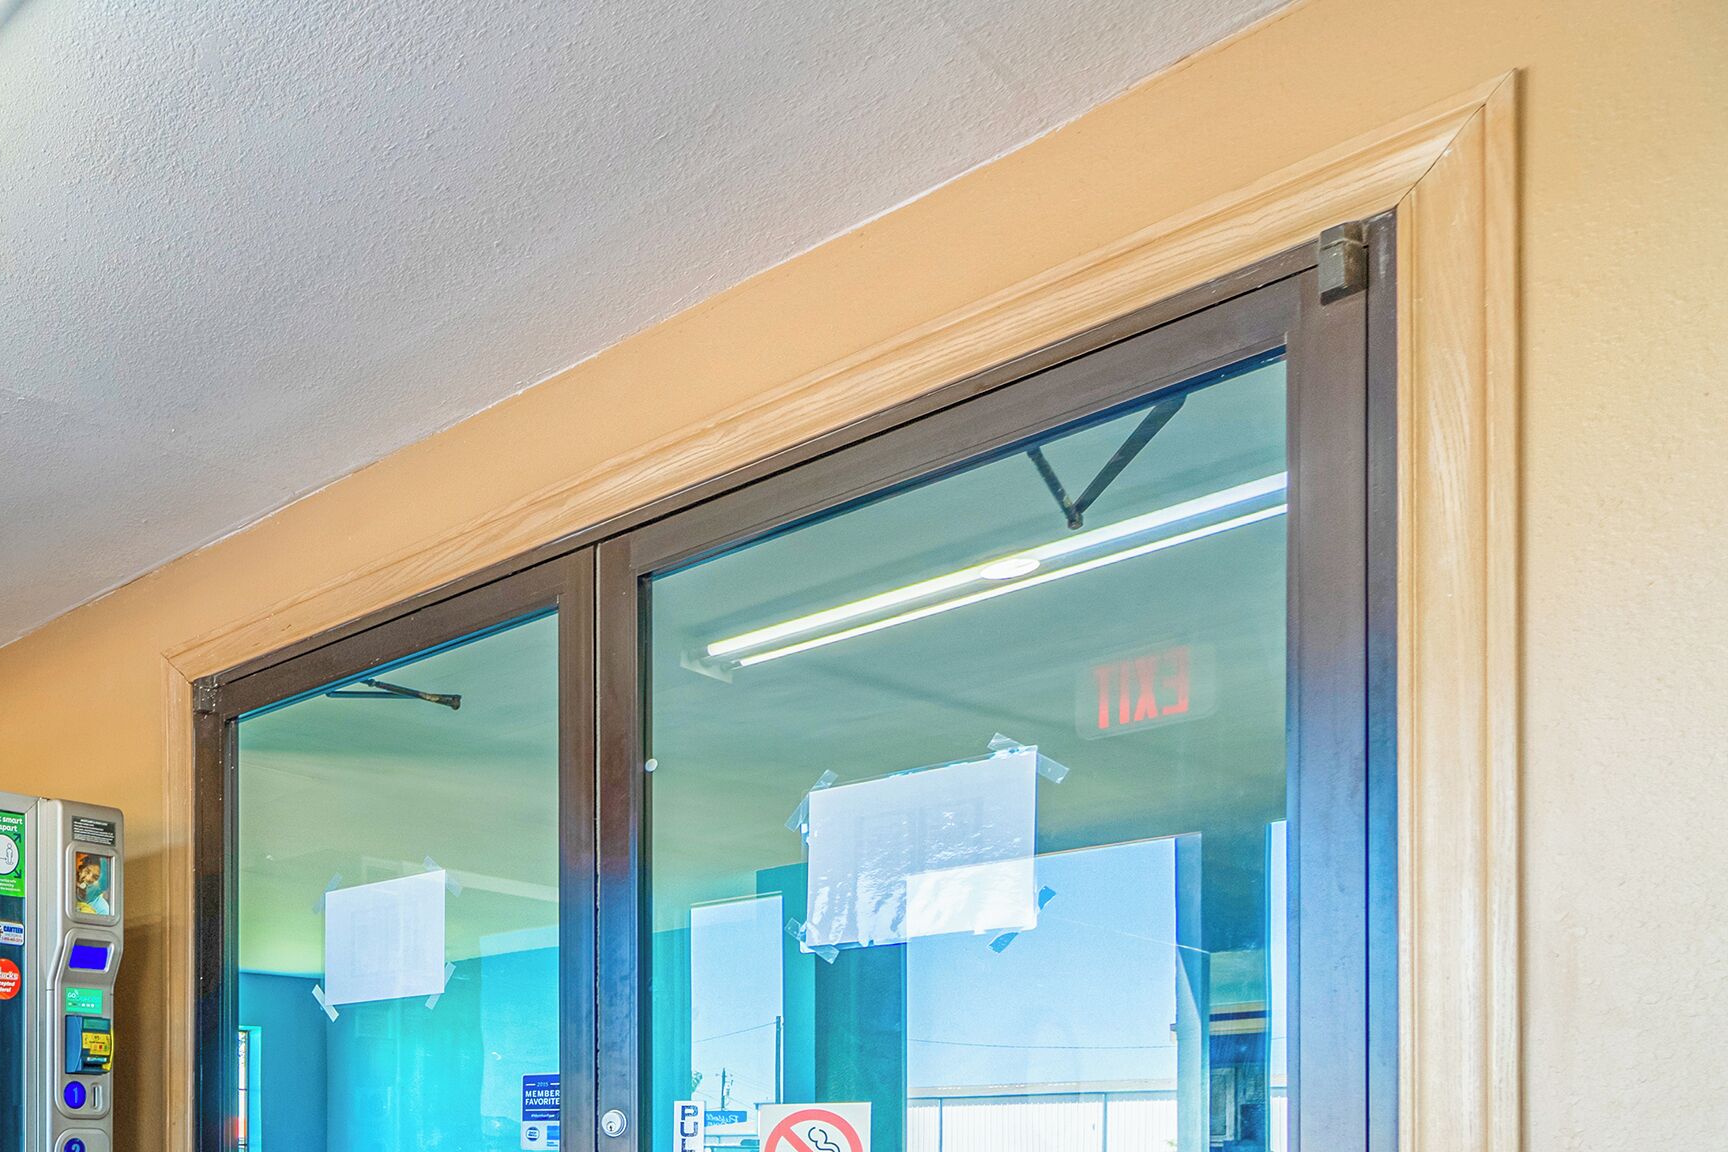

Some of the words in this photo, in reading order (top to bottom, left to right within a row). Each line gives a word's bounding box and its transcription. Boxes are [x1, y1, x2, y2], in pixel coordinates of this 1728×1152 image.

[2, 815, 22, 825] smart
[73, 1086, 78, 1104] 1
[525, 1089, 560, 1098] MEMBER
[525, 1097, 560, 1106] FAVORITE
